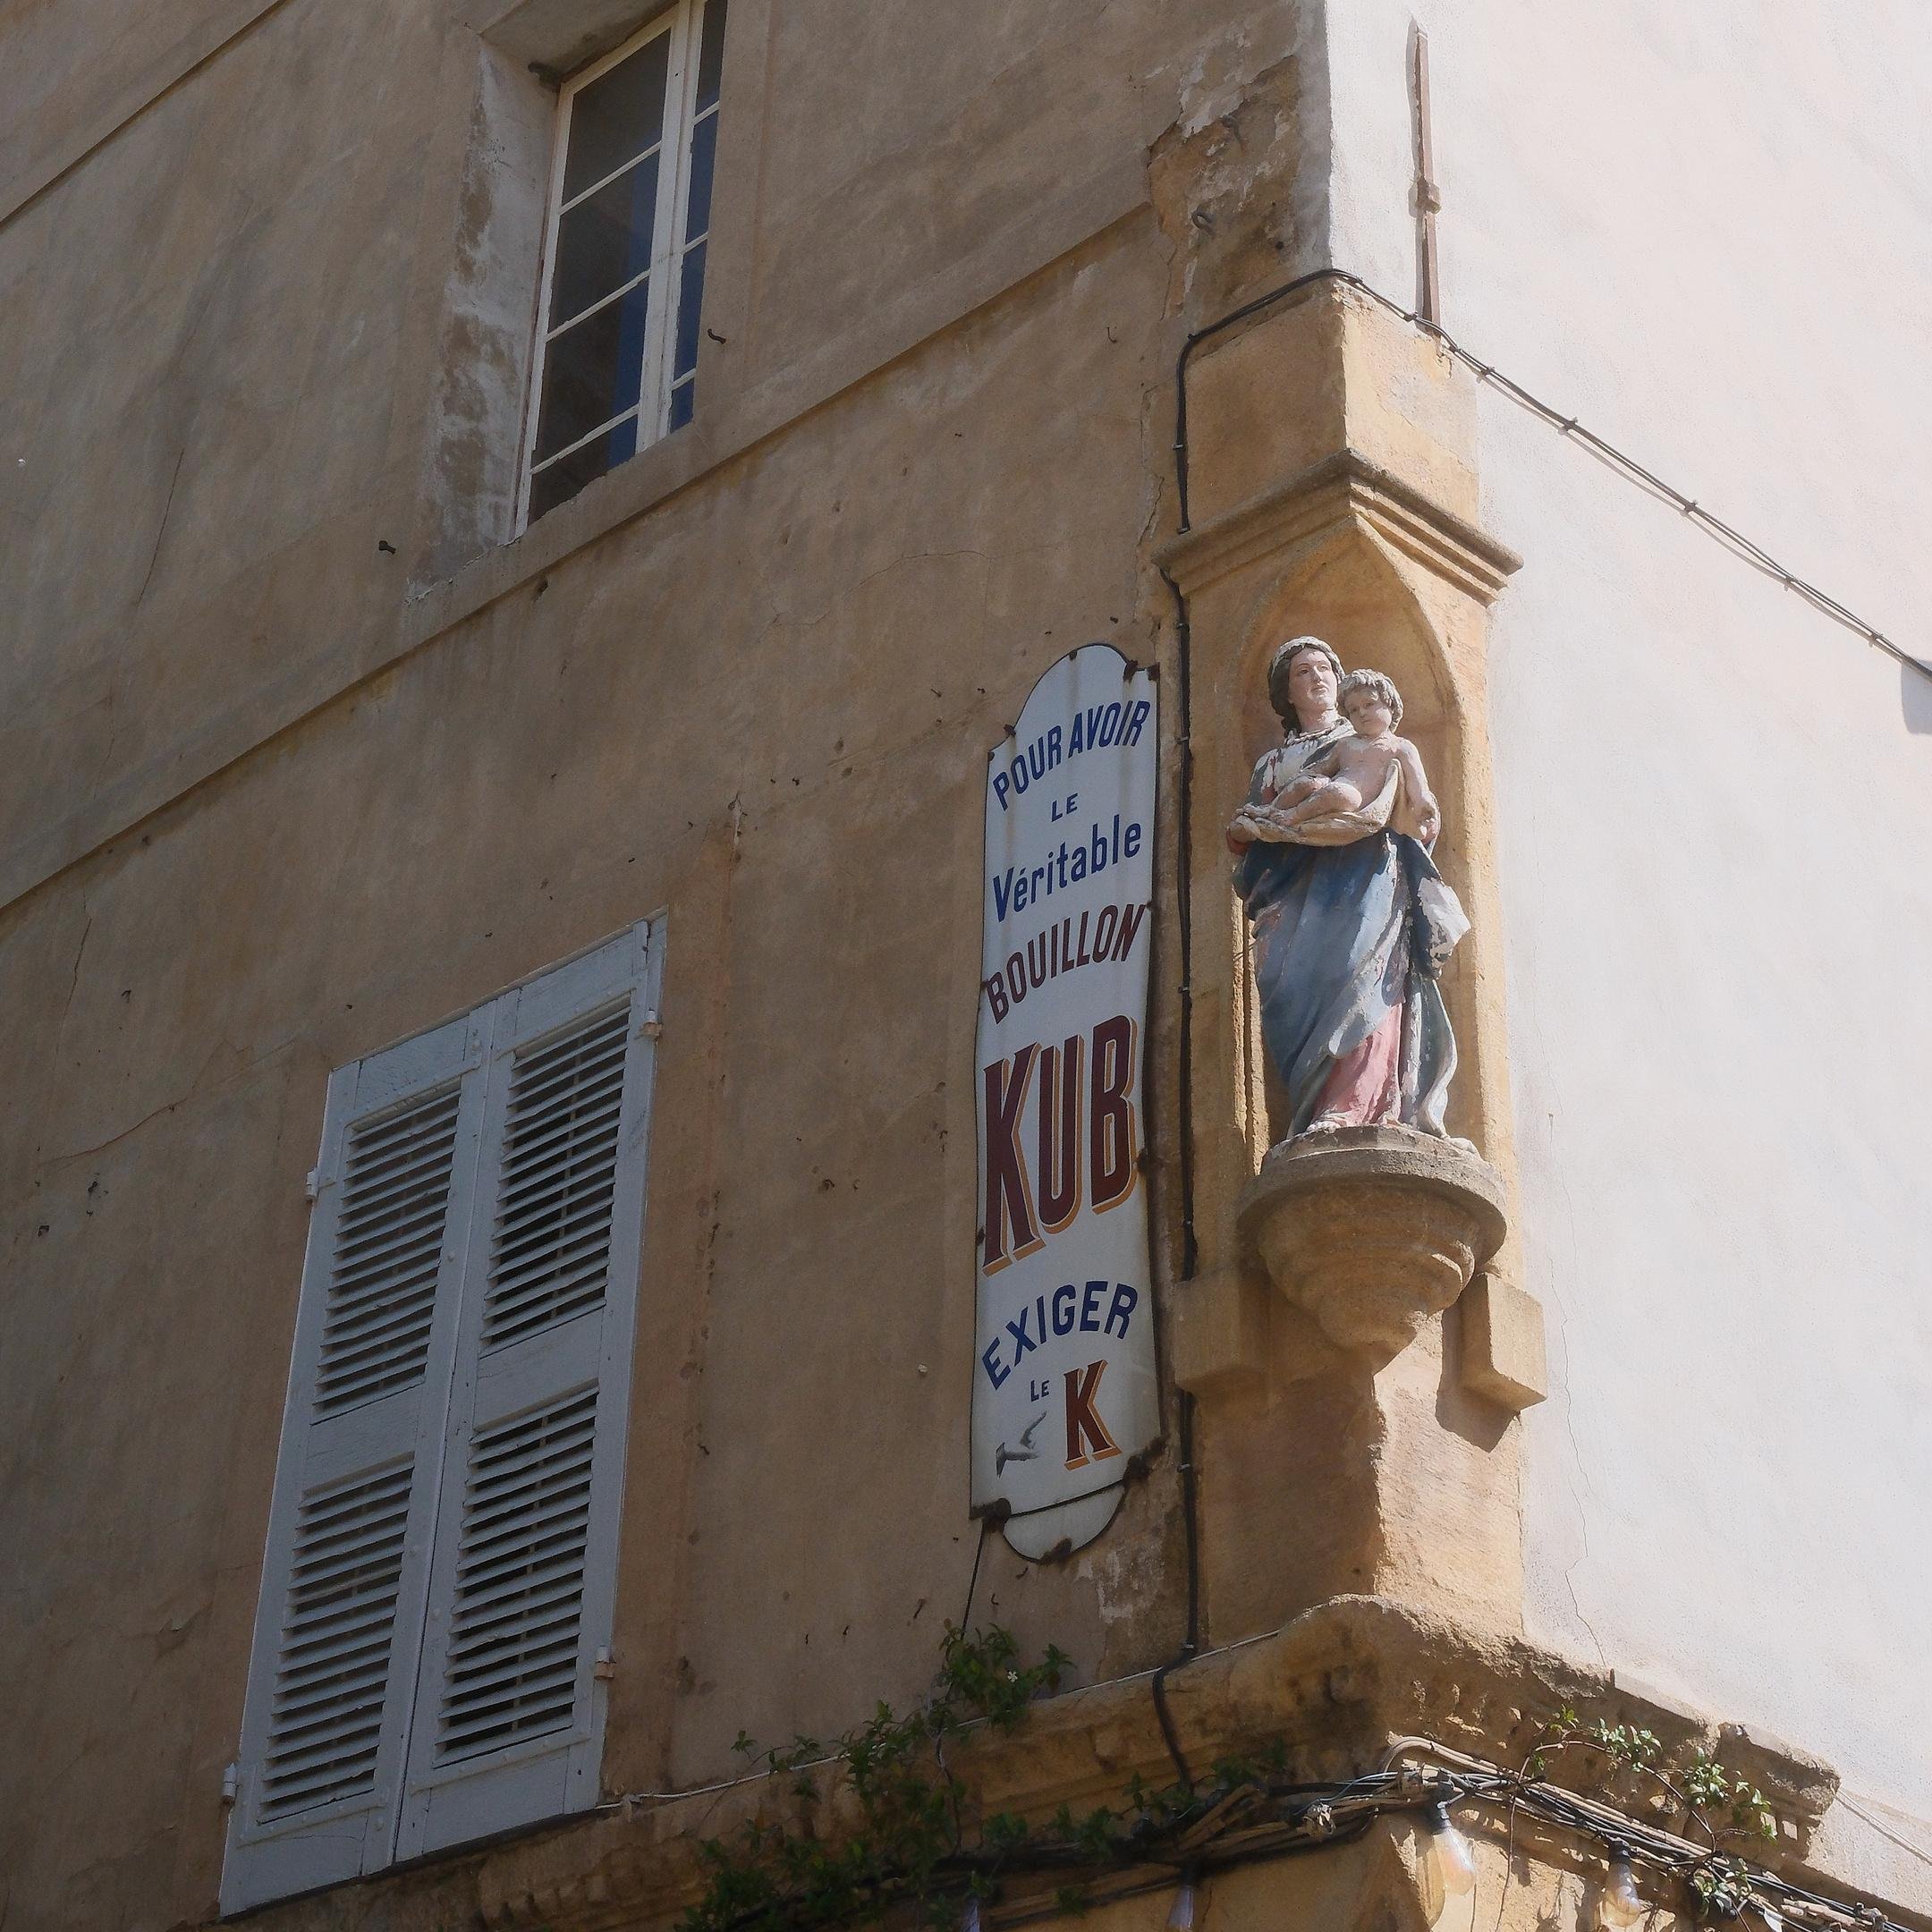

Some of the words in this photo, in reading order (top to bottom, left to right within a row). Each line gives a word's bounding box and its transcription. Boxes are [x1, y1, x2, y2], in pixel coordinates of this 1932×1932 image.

[993, 724, 1062, 811] POUR
[1068, 700, 1150, 758] AVOIR
[1051, 792, 1078, 822] LE
[993, 814, 1141, 923] Véritable
[986, 903, 1145, 1024] BOUILLON
[983, 1014, 1138, 1275] KUB
[982, 1281, 1139, 1390] EXIGER
[1030, 1379, 1050, 1402] LE
[1063, 1360, 1123, 1470] K
